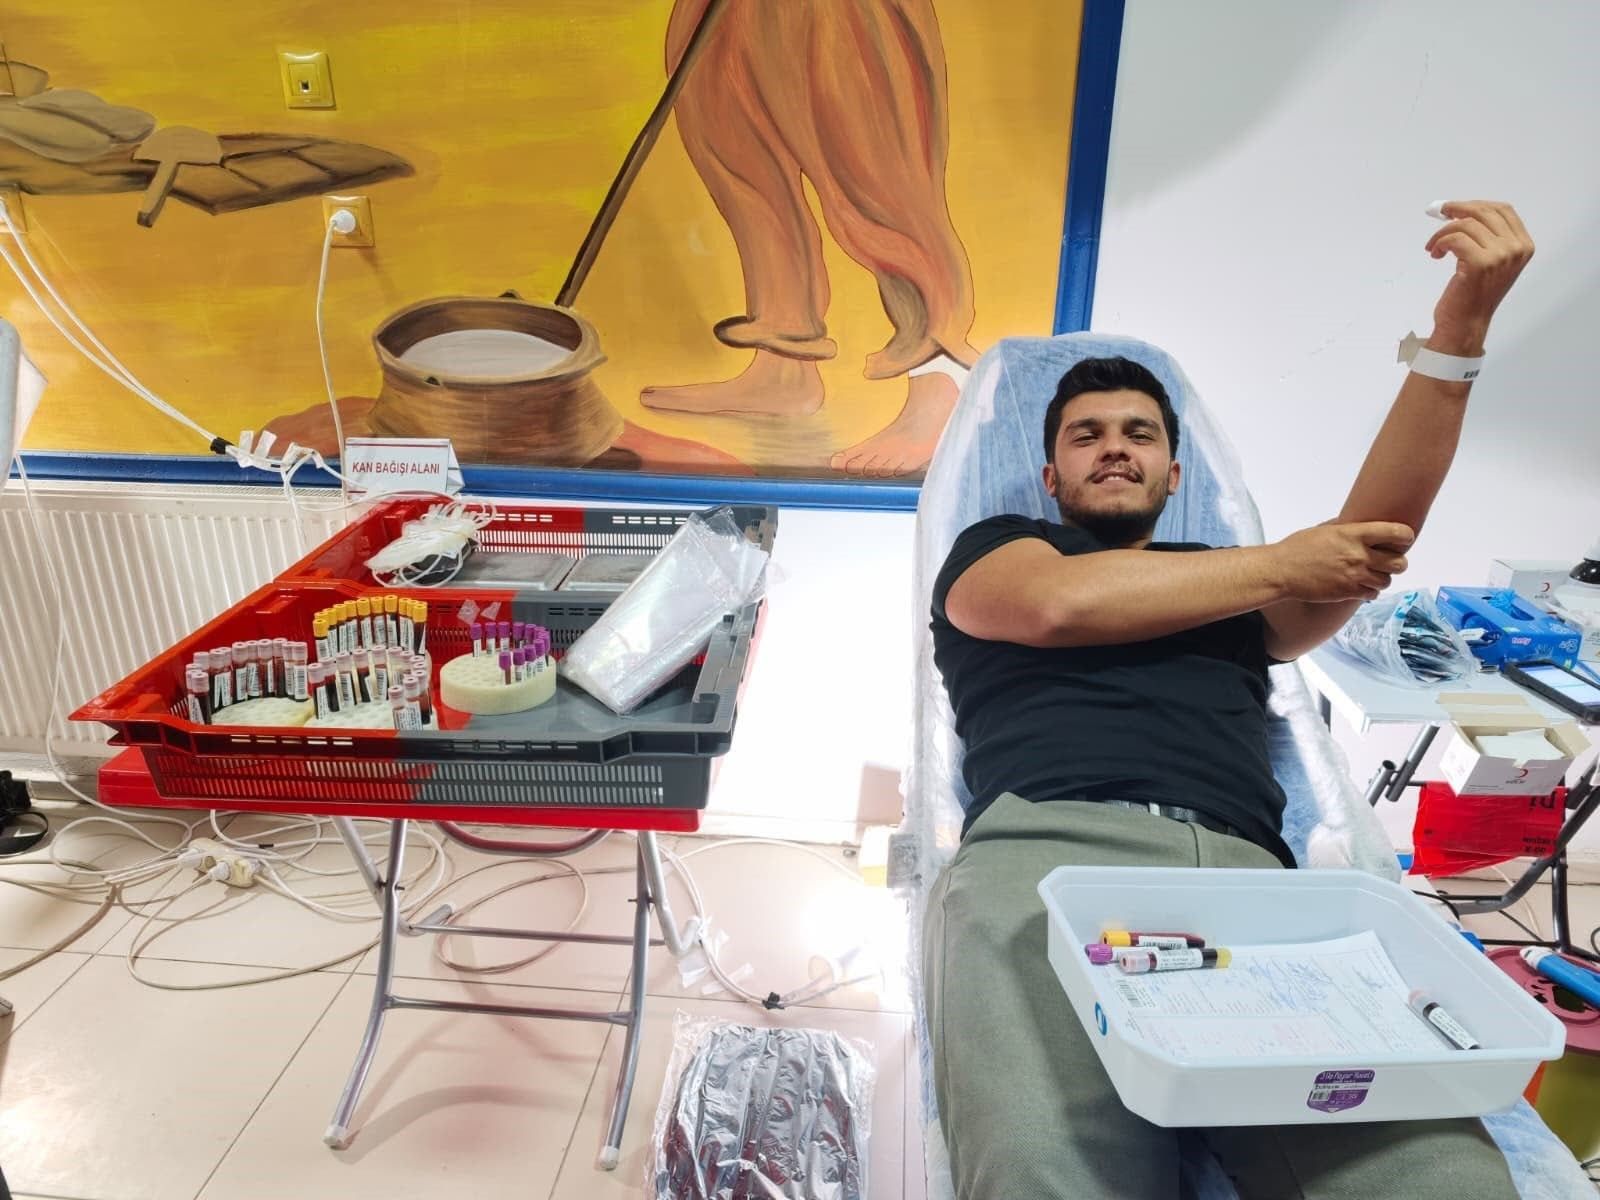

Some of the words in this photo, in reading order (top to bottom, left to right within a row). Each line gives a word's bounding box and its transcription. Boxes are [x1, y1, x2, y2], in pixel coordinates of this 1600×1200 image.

[352, 462, 373, 473] KAN
[375, 460, 409, 476] BAĞIŞI
[410, 463, 440, 474] ALANI
